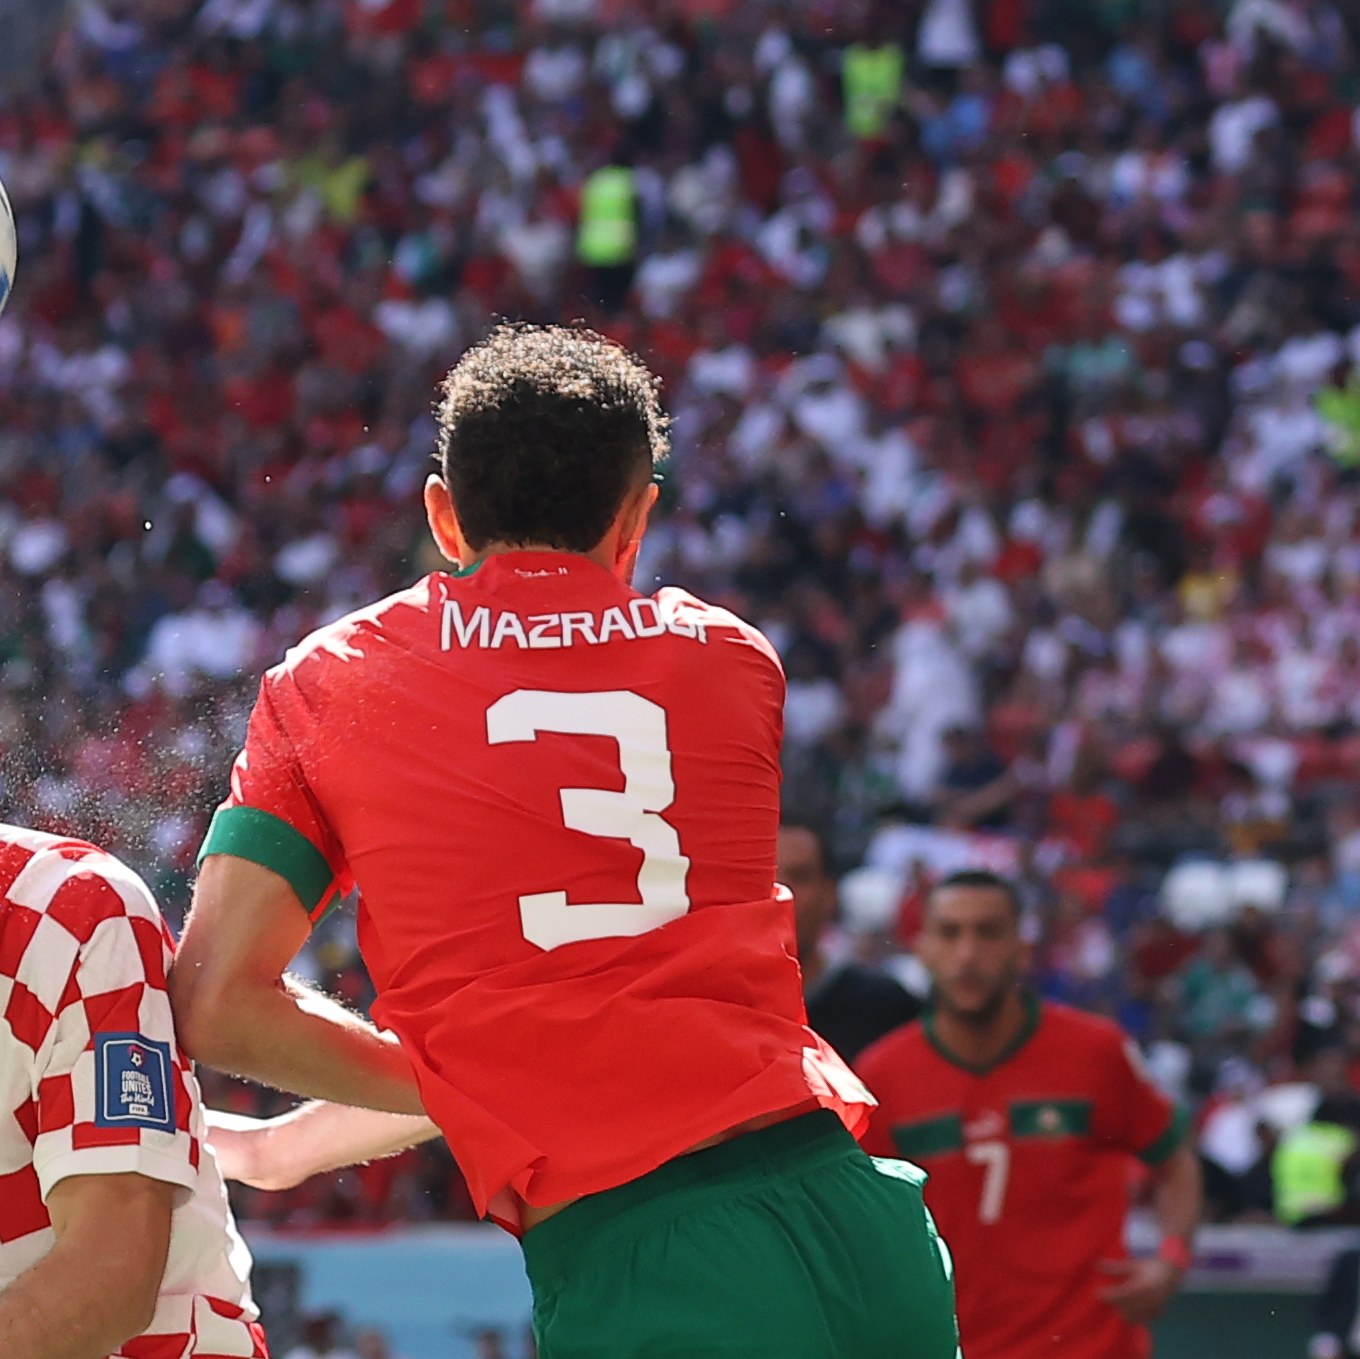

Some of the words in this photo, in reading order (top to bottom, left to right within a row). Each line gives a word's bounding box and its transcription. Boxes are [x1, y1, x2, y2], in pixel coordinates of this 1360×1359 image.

[486, 689, 690, 952] 3
[121, 1080, 152, 1095] UNITES
[965, 1141, 1010, 1224] 7
